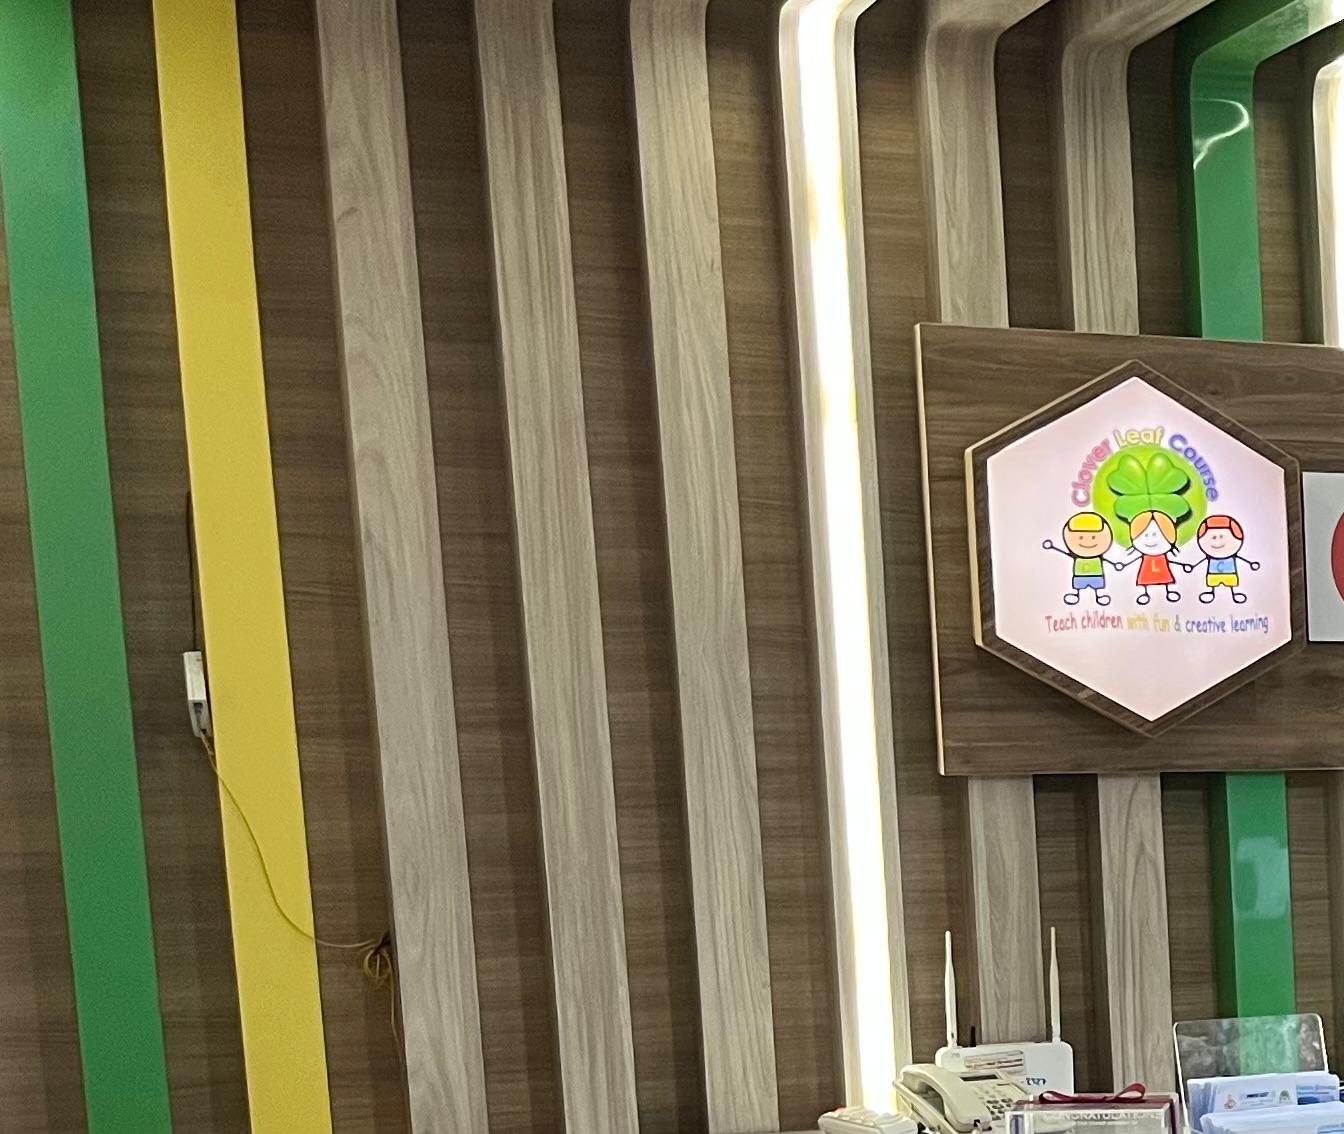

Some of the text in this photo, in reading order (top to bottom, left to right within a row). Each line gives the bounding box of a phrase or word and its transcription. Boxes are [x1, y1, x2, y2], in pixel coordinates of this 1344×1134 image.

[1071, 426, 1220, 507] Clover Leaf Course
[1045, 612, 1077, 632] Teach
[1081, 610, 1123, 630] children
[1153, 611, 1171, 632] fun
[1185, 614, 1226, 632] creative
[1231, 614, 1269, 634] learning
